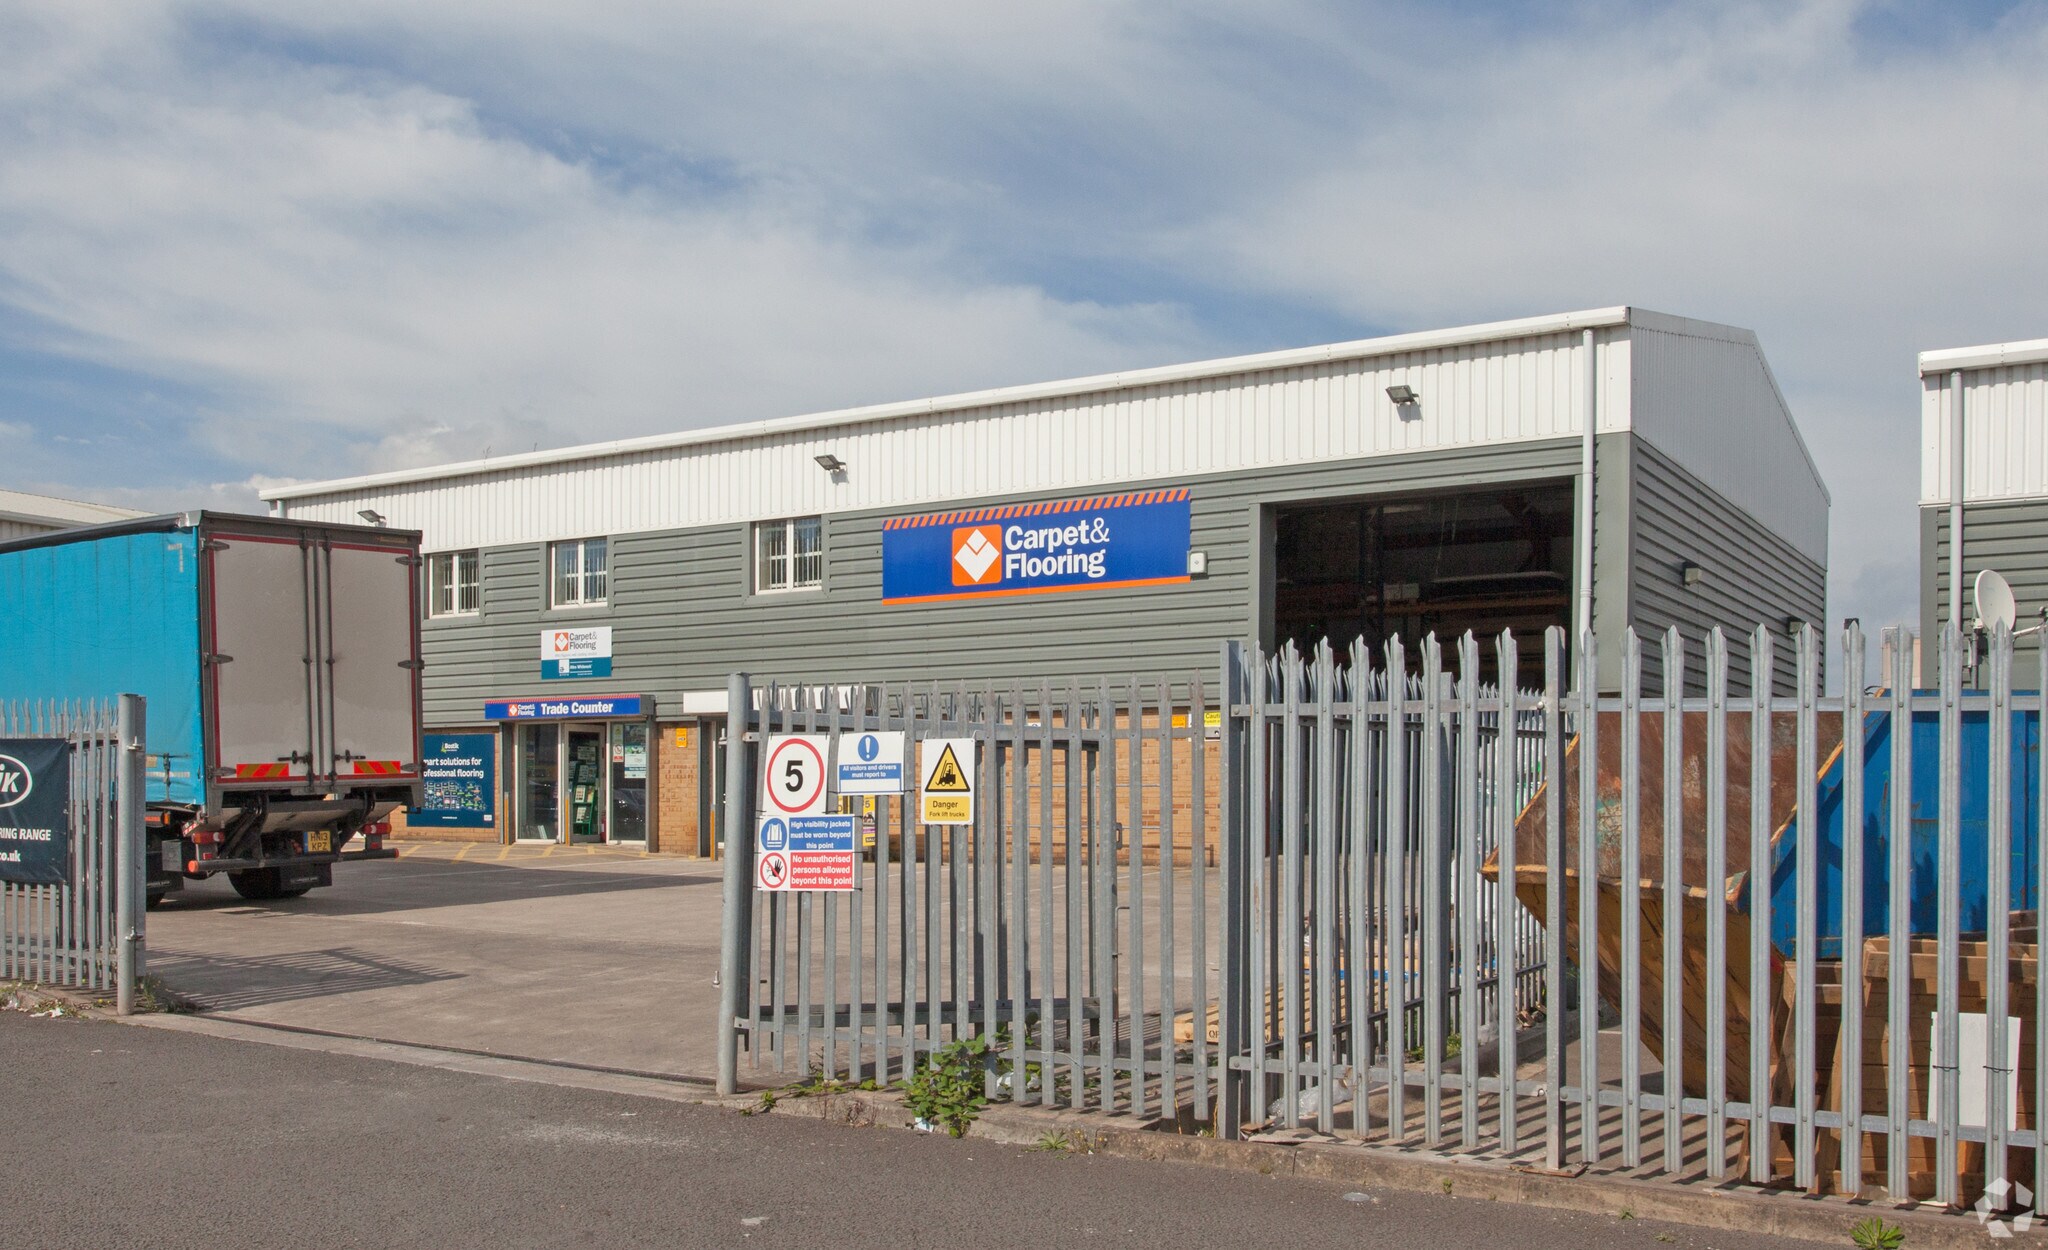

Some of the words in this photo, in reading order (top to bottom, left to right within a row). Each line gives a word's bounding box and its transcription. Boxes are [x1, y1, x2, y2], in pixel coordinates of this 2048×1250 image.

[1005, 517, 1110, 553] Carpet&
[1006, 549, 1106, 578] Flooring
[569, 641, 596, 650] Flooring
[540, 702, 569, 715] Trade
[571, 701, 614, 714] Counter
[440, 757, 470, 766] solutions
[471, 756, 482, 766] for
[457, 768, 484, 778] flooring
[785, 760, 804, 792] 5
[933, 800, 958, 810] Danger
[791, 821, 803, 829] High
[19, 828, 52, 840] RANGE
[829, 831, 851, 839] beyond
[311, 842, 328, 850] KPZ
[804, 855, 850, 863] unauthorised
[792, 867, 821, 875] persons
[792, 877, 817, 885] beyond
[834, 876, 852, 886] point
